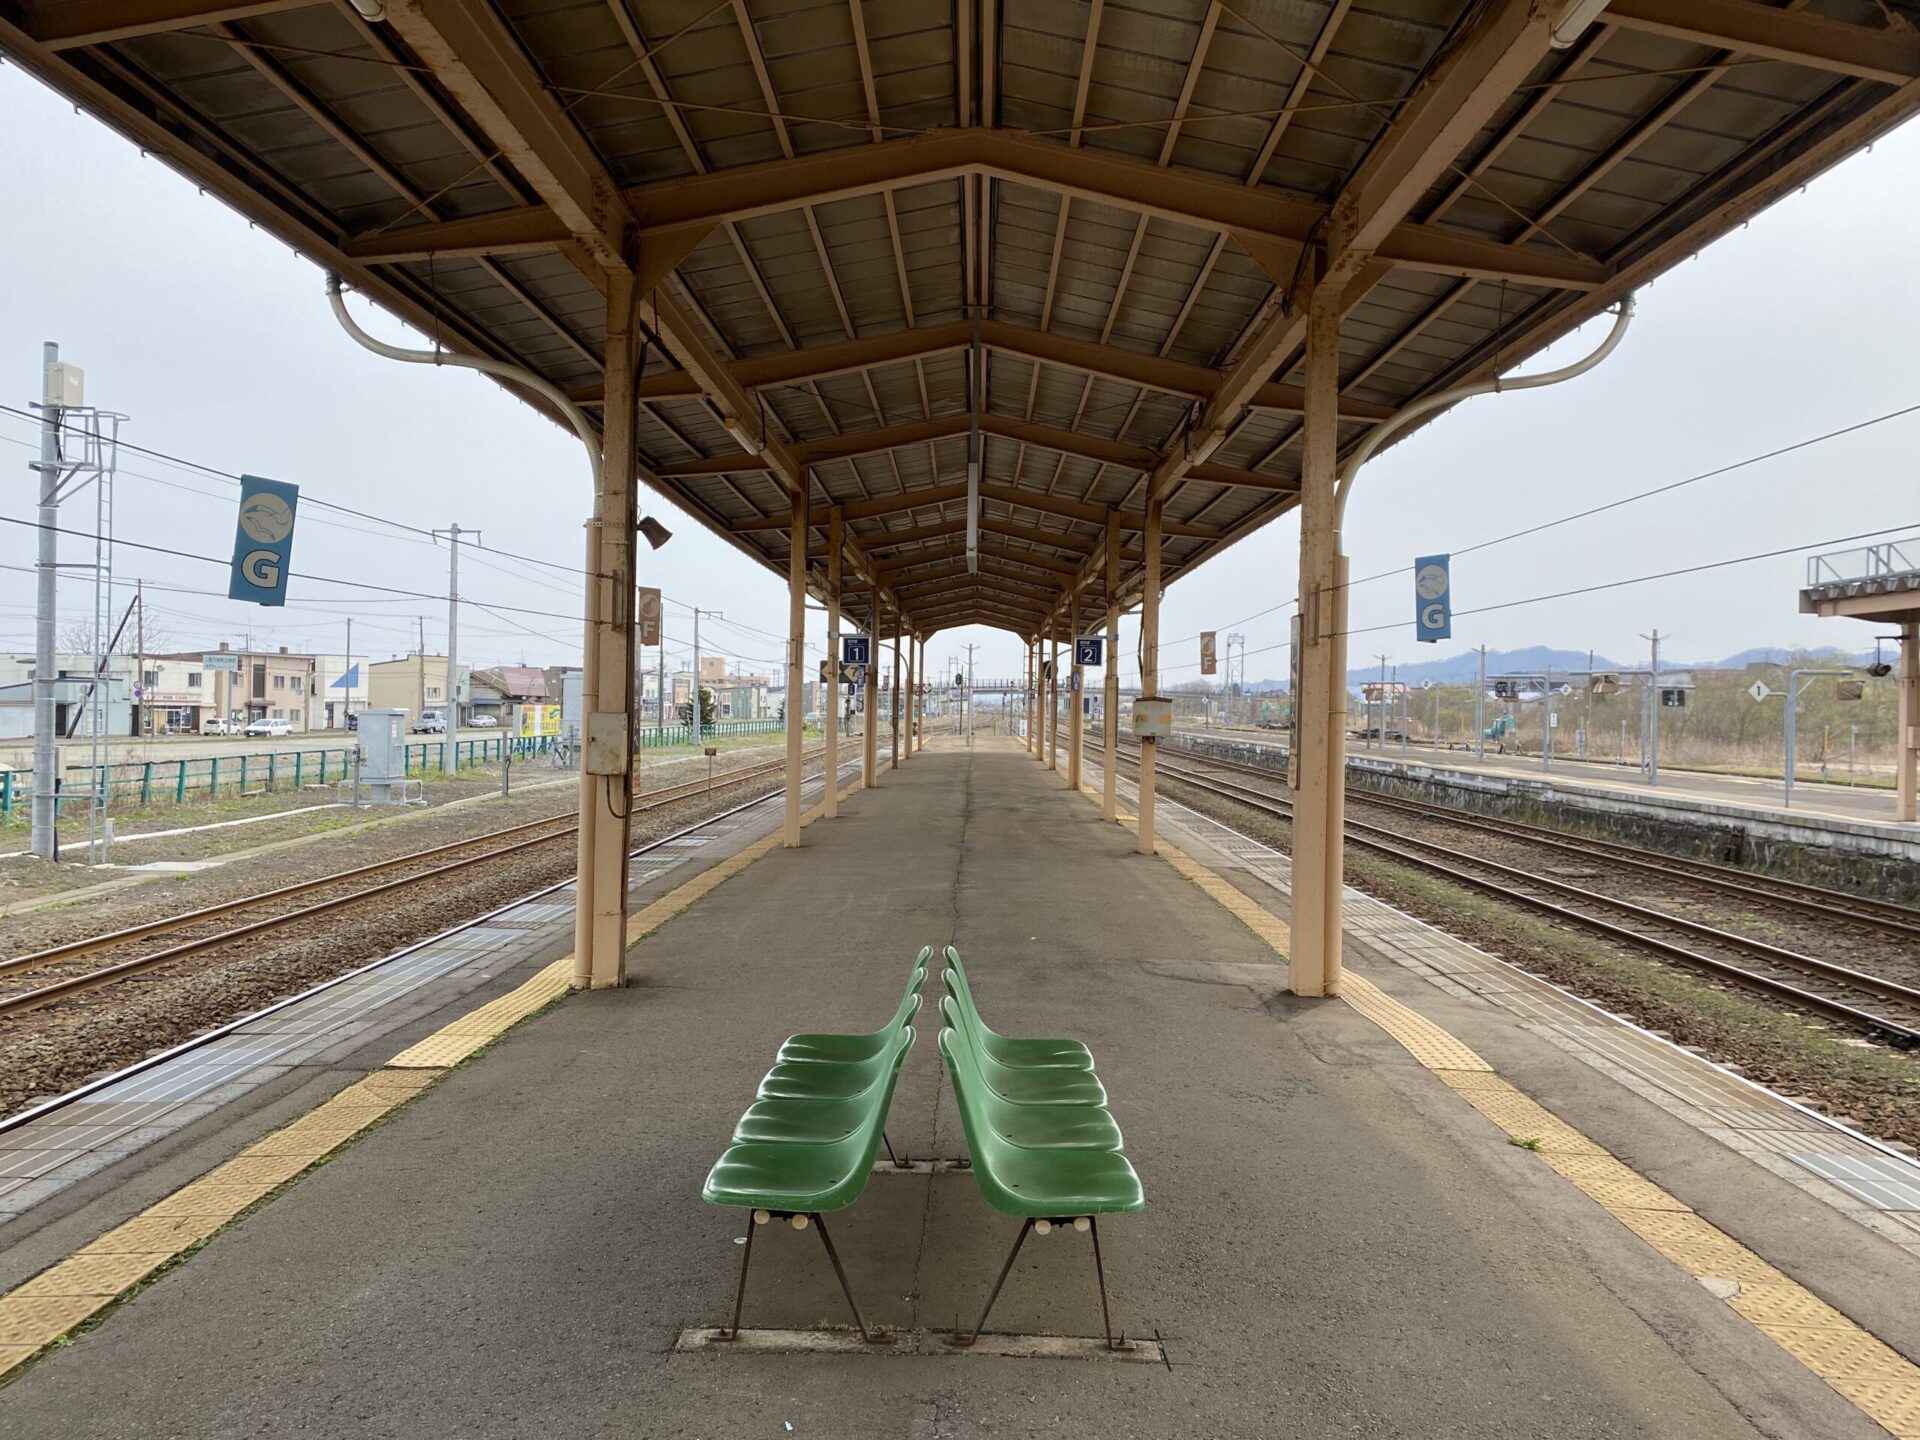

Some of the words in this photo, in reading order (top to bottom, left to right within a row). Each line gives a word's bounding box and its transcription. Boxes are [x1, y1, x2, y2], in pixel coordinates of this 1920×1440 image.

[241, 549, 282, 589] G
[1421, 602, 1446, 631] G
[643, 620, 655, 637] F
[852, 647, 860, 661] 1
[1084, 648, 1093, 662] 2
[1203, 656, 1213, 670] F
[850, 666, 859, 678] 7
[1757, 686, 1761, 696] 1
